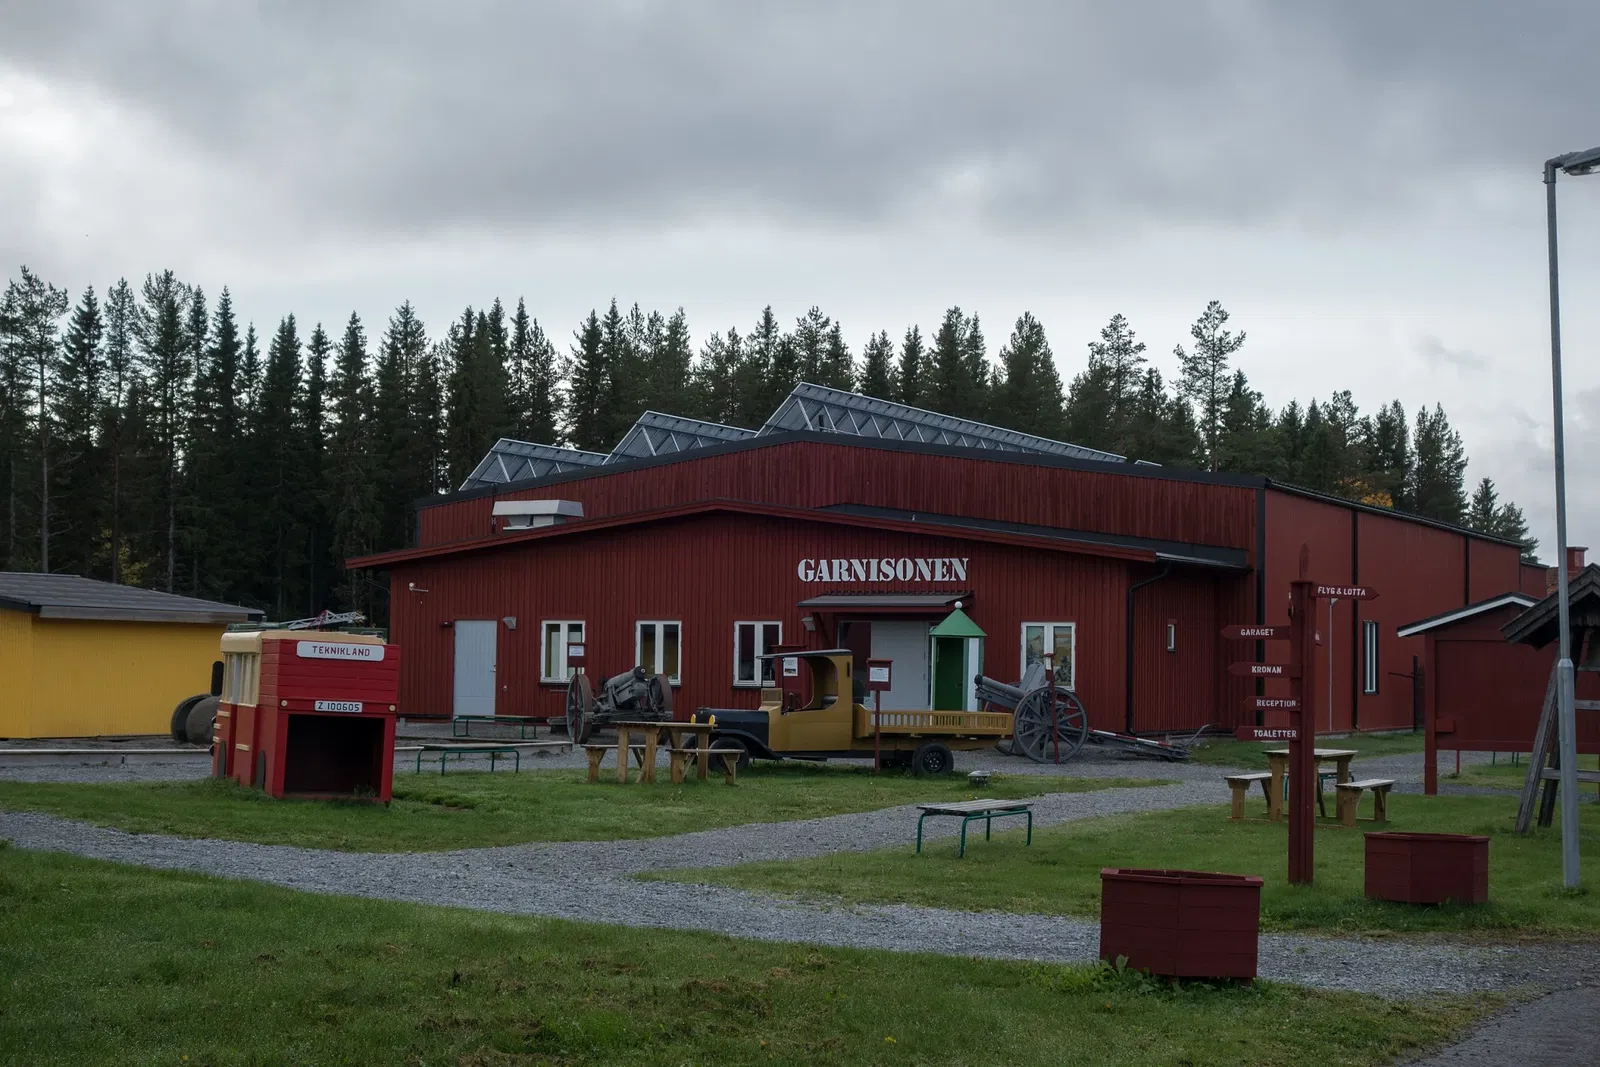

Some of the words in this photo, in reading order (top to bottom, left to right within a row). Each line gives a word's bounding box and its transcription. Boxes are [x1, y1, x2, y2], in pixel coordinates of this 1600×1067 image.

[797, 557, 969, 582] GARNISONEN
[1317, 586, 1335, 595] FLYG
[1336, 587, 1342, 595] &
[1343, 588, 1366, 596] LOTTA
[1240, 628, 1274, 636] GARAGET
[312, 645, 370, 657] TEKNIKLAND
[1251, 665, 1282, 674] KRONAN
[317, 701, 324, 709] Z
[327, 702, 360, 711] 100605
[1256, 699, 1296, 707] RECEPTION
[1253, 729, 1297, 738] TOALETTER
